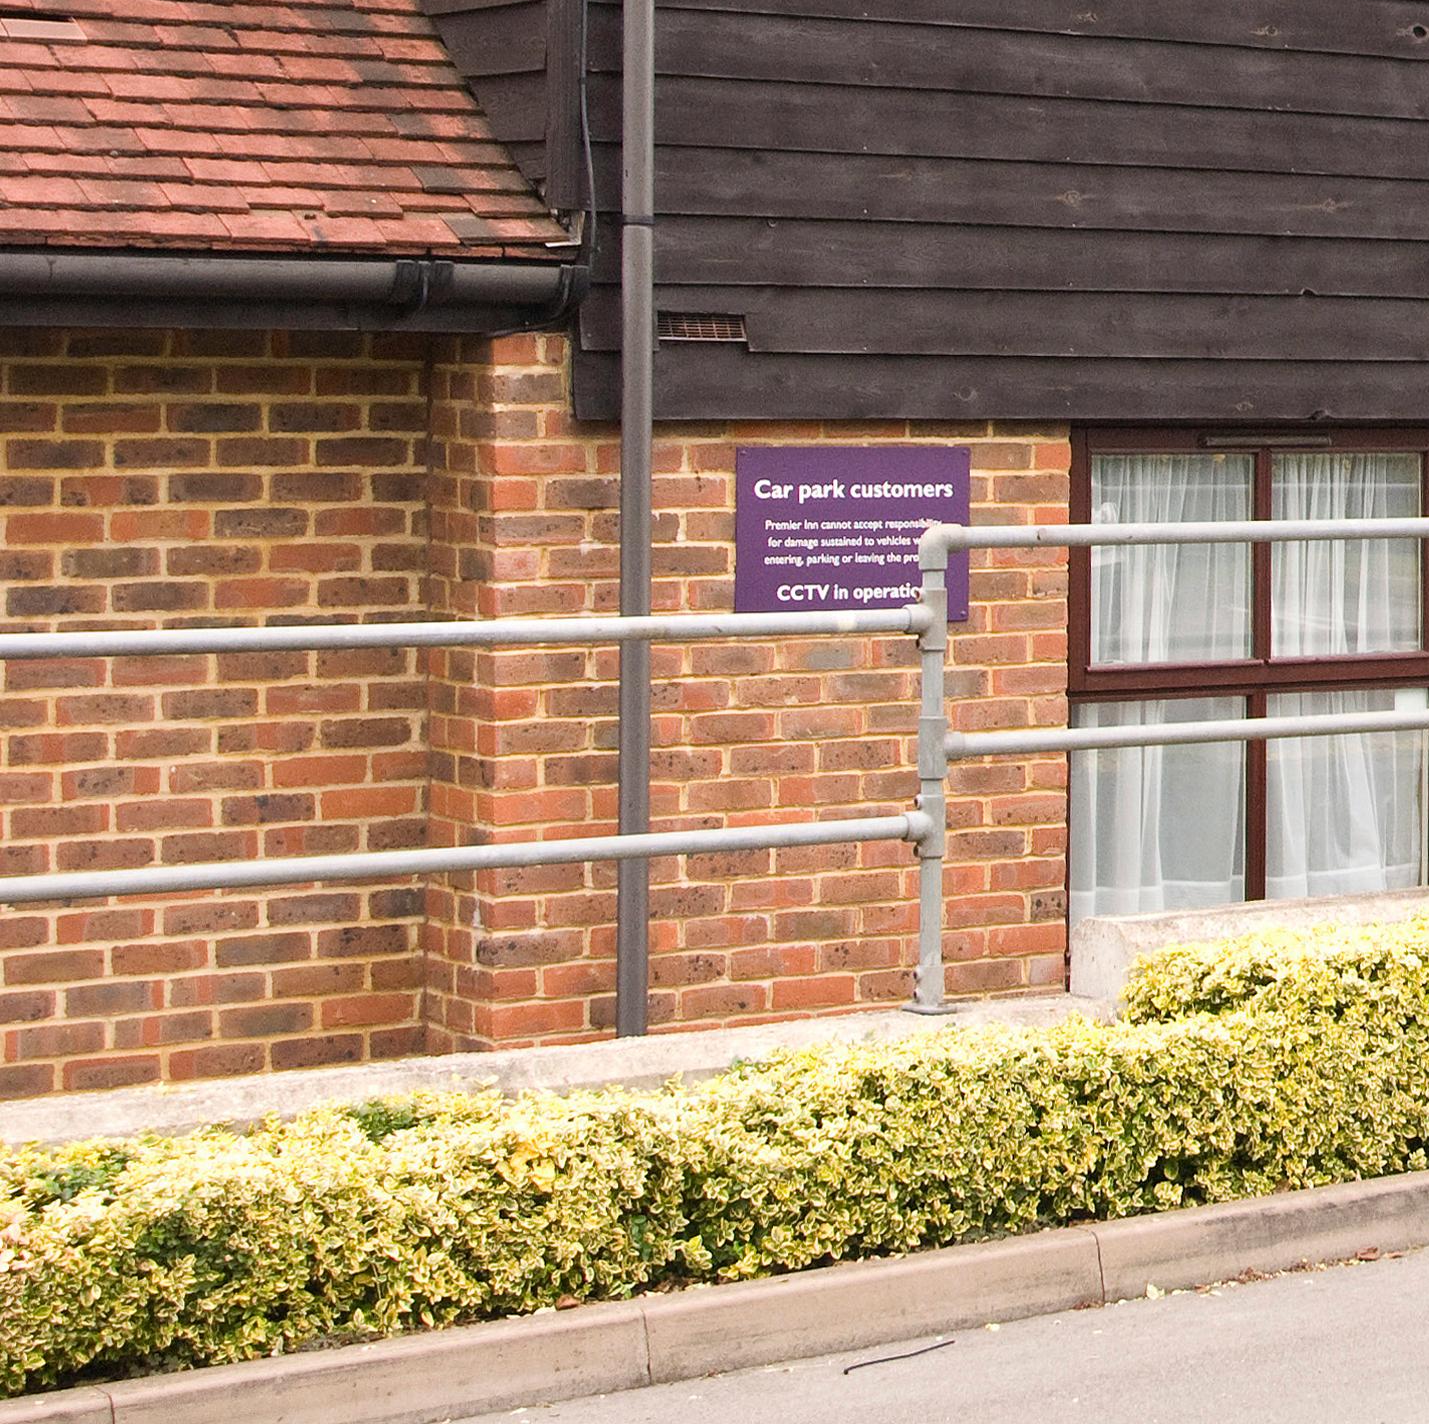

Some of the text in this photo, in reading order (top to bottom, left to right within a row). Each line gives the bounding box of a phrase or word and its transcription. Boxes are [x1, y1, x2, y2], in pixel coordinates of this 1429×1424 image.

[754, 479, 954, 503] Car park customers
[765, 519, 802, 530] Premier
[804, 519, 819, 530] Inn
[821, 521, 852, 530] cannot
[854, 521, 883, 532] accept
[768, 537, 783, 547] for
[784, 537, 819, 550] damage
[821, 536, 862, 547] sustained
[864, 537, 875, 546] to
[876, 536, 911, 546] vehicles
[764, 555, 804, 567] entering,
[806, 554, 840, 567] parking
[842, 555, 854, 564] or
[855, 552, 885, 565] leaving
[886, 552, 901, 563] the
[777, 582, 921, 603] CCTV in operatio
